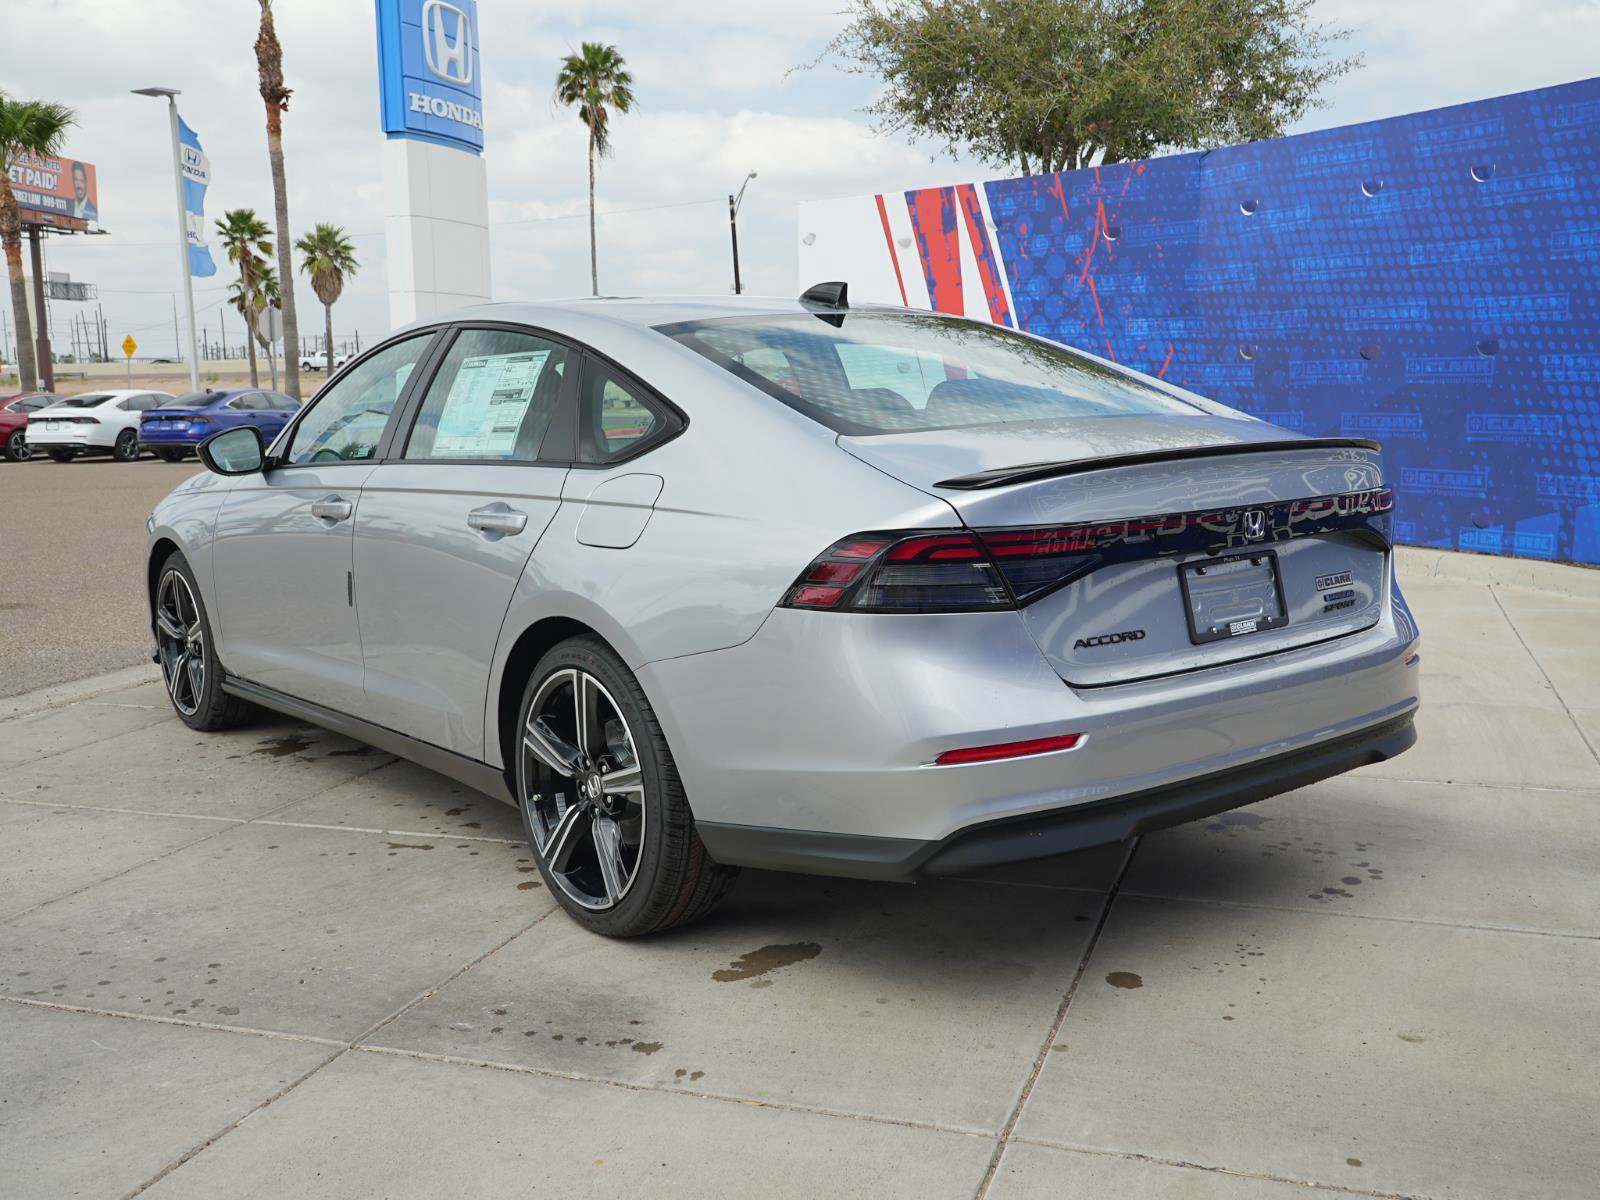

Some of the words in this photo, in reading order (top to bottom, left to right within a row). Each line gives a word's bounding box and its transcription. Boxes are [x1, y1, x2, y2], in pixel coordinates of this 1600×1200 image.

[409, 92, 483, 131] HONDA
[8, 165, 24, 184] ET
[26, 169, 57, 191] PAID!
[1324, 573, 1351, 587] CLARK
[1073, 630, 1146, 650] ACCORD
